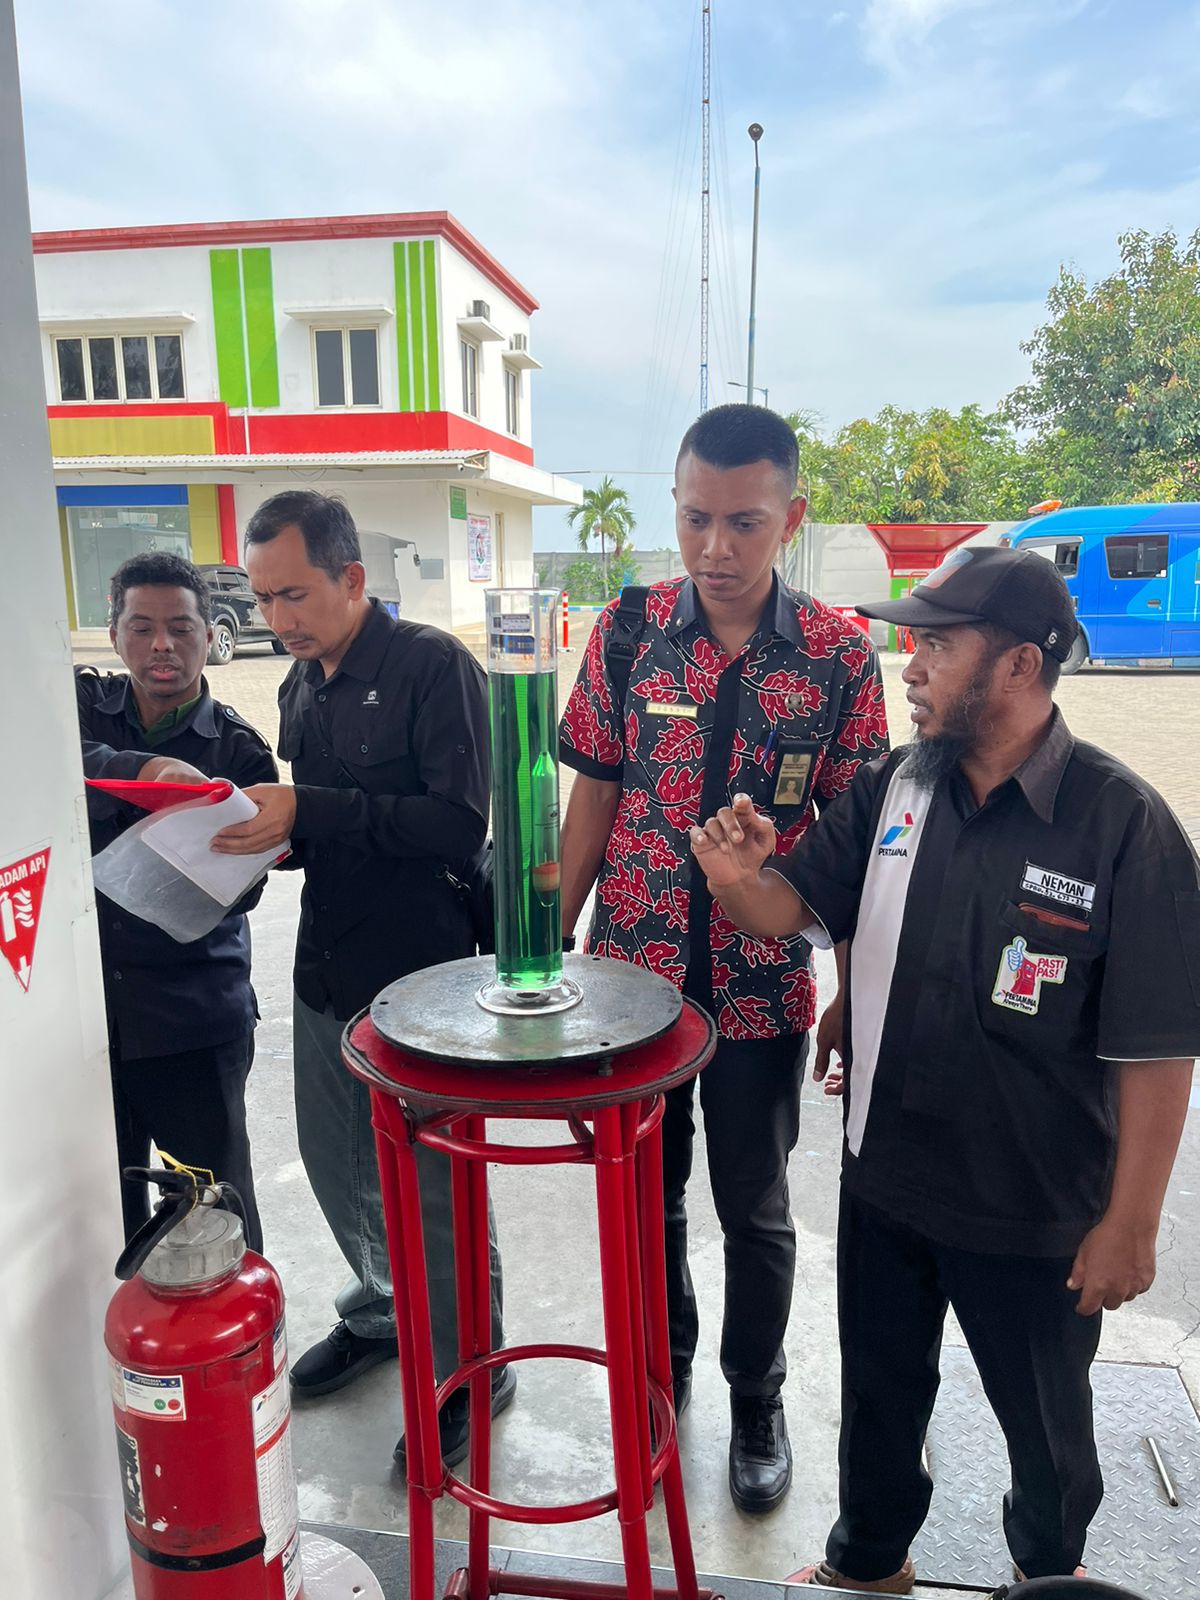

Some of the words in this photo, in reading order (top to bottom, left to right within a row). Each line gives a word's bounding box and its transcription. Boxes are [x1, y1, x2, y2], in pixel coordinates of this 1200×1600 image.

[30, 855, 46, 875] API
[1041, 873, 1085, 897] NEMAN
[1037, 958, 1065, 969] PASTI
[1036, 968, 1059, 978] PAS!
